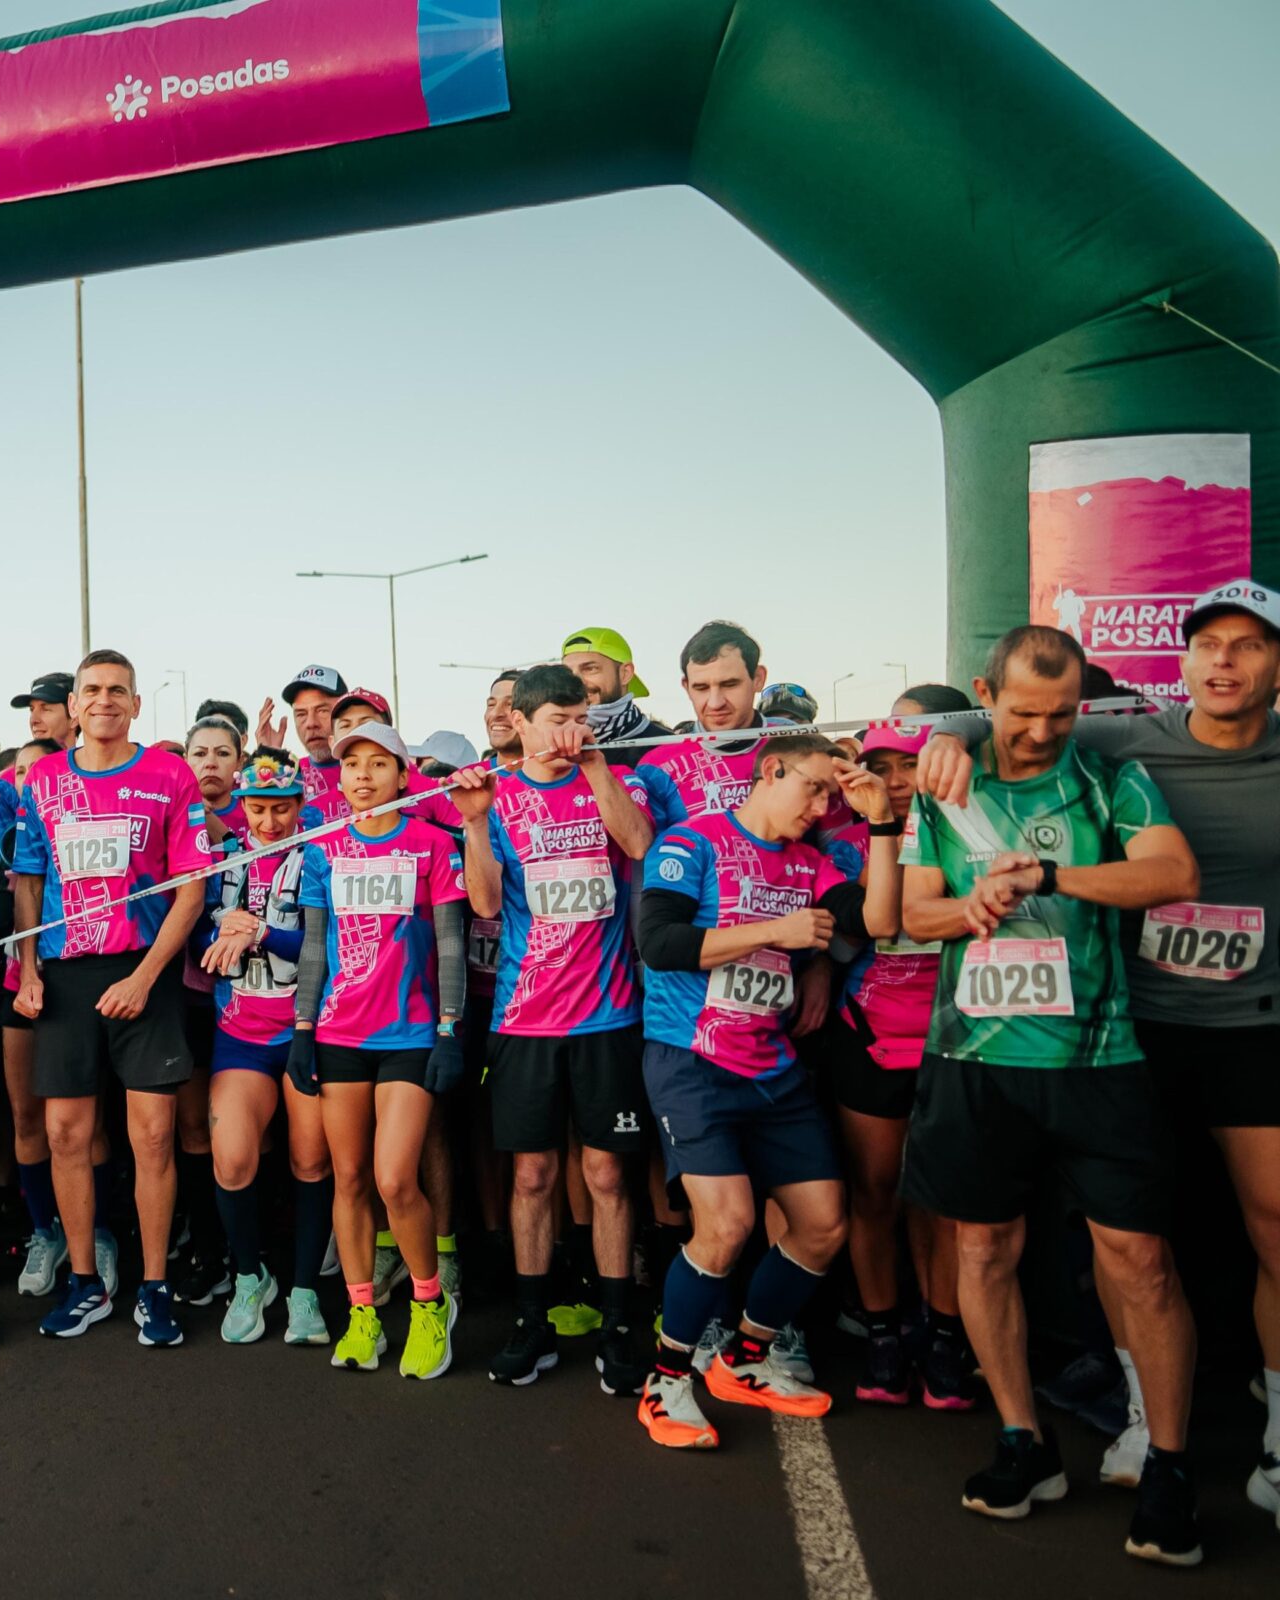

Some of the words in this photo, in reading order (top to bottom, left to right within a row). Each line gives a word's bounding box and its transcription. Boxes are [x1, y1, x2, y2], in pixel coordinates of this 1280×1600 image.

[161, 59, 289, 103] Posadas
[1092, 605, 1192, 626] MARAT
[1091, 626, 1186, 648] POSA
[65, 838, 118, 872] 1125
[546, 834, 606, 852] POSADAS
[343, 874, 403, 905] 1164
[535, 877, 607, 915] 1228
[752, 899, 801, 915] POSADA
[477, 936, 499, 965] 17
[1156, 924, 1251, 970] 1026
[723, 963, 786, 1010] 1322
[968, 963, 1057, 1006] 1029
